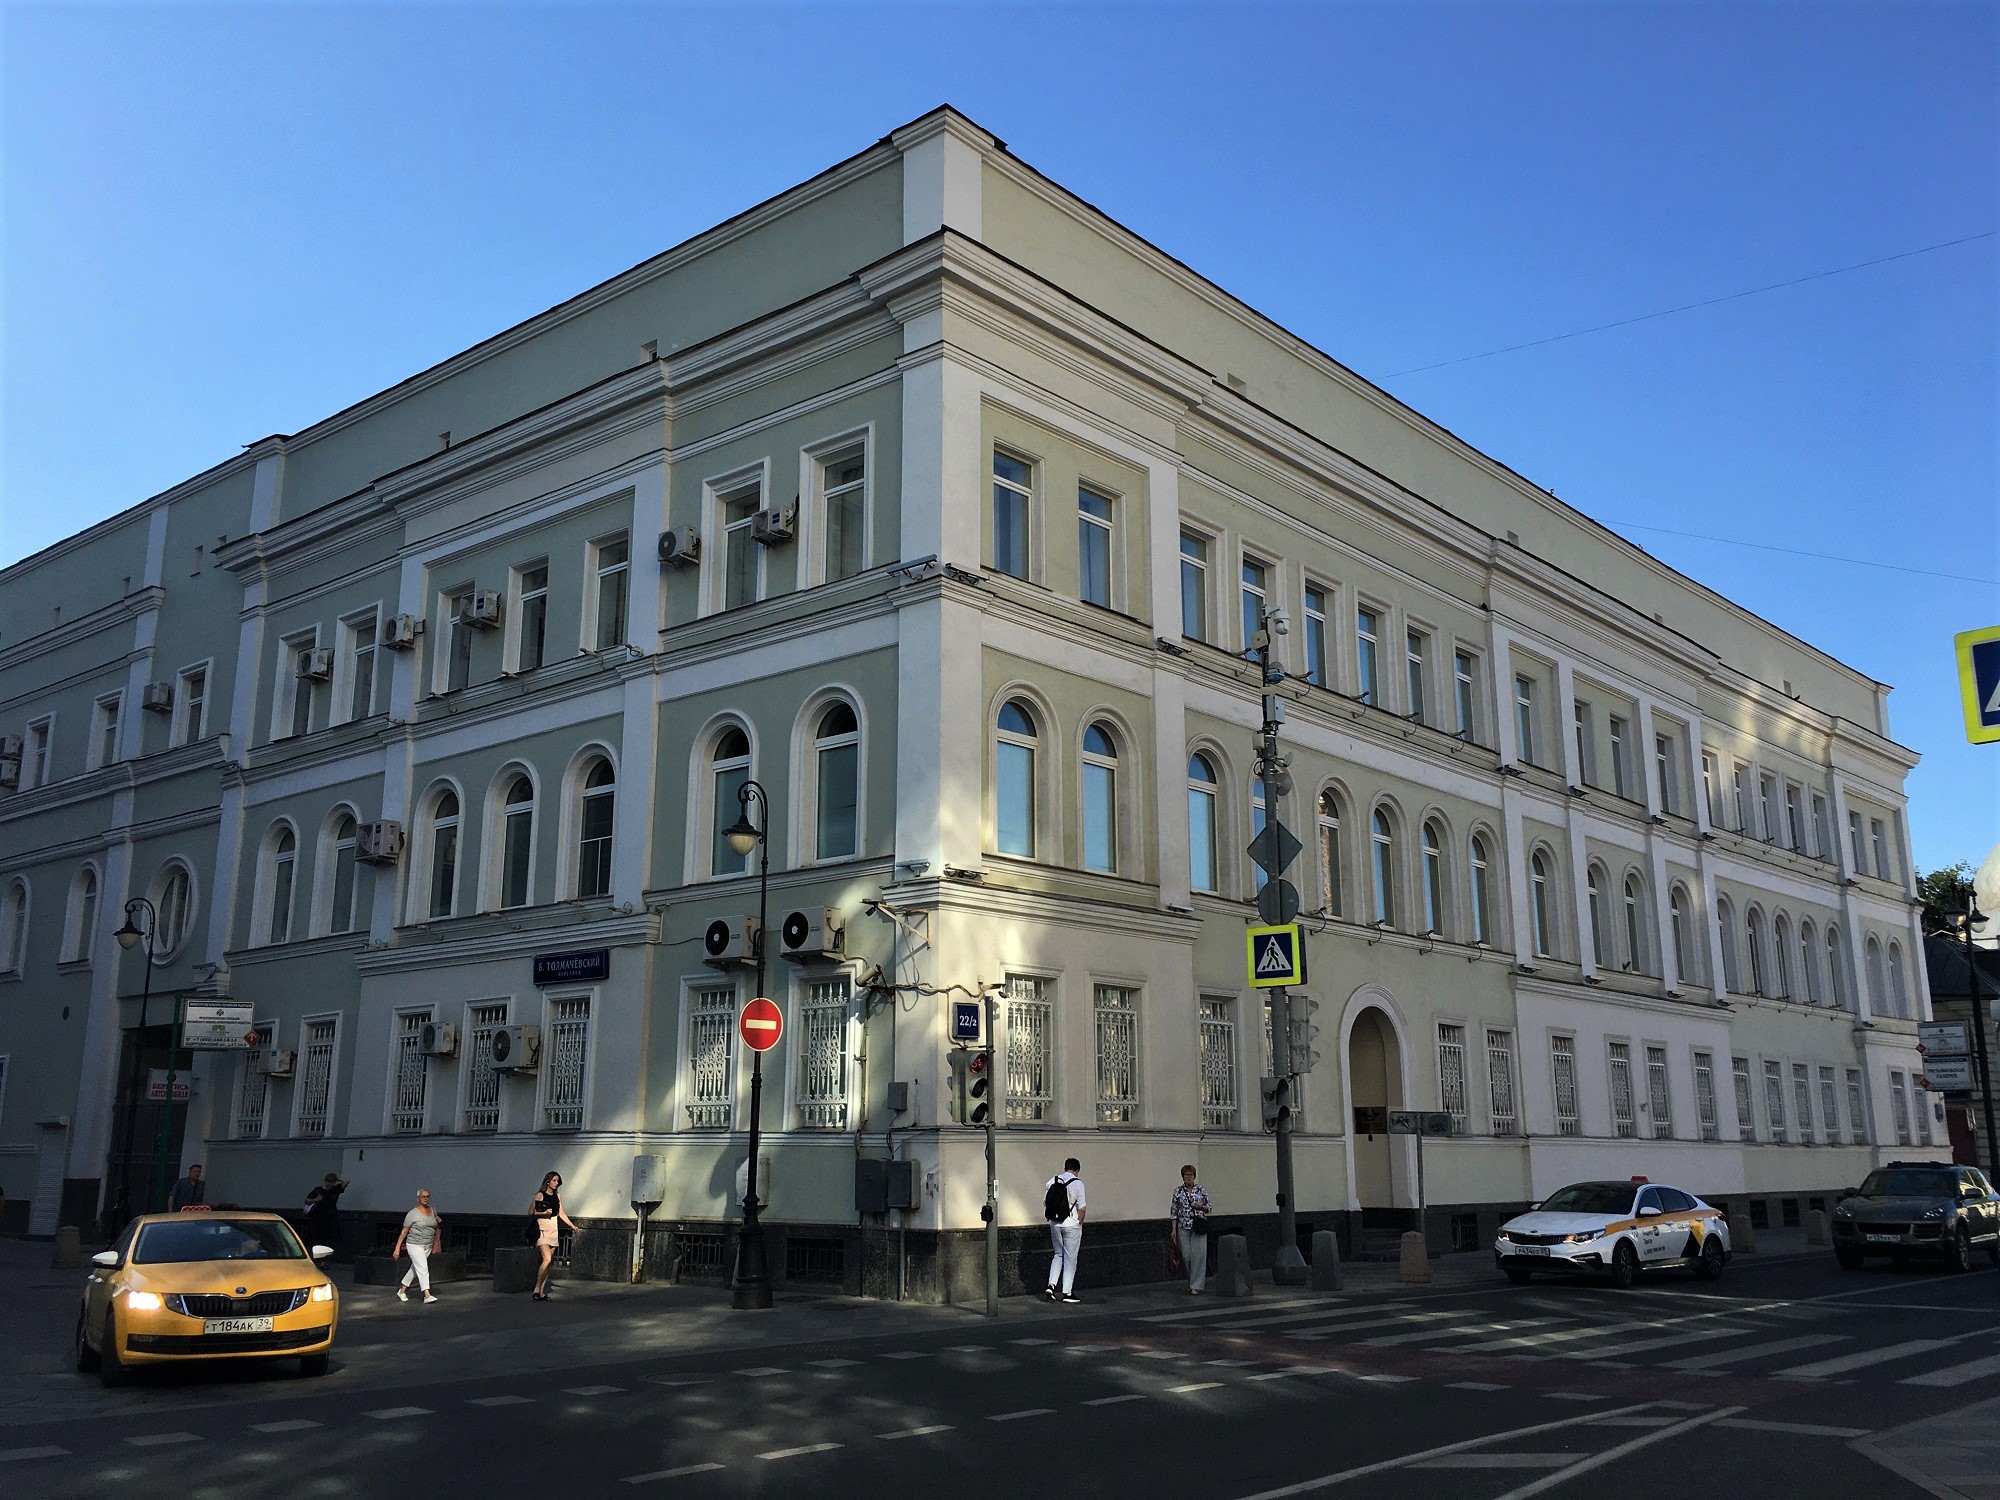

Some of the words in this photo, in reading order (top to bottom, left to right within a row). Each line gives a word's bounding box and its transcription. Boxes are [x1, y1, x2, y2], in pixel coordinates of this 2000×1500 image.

[538, 962, 545, 972] Б.
[546, 955, 601, 972] ТОЛМАЧЁВСКИЙ
[959, 1014, 977, 1028] 22/2
